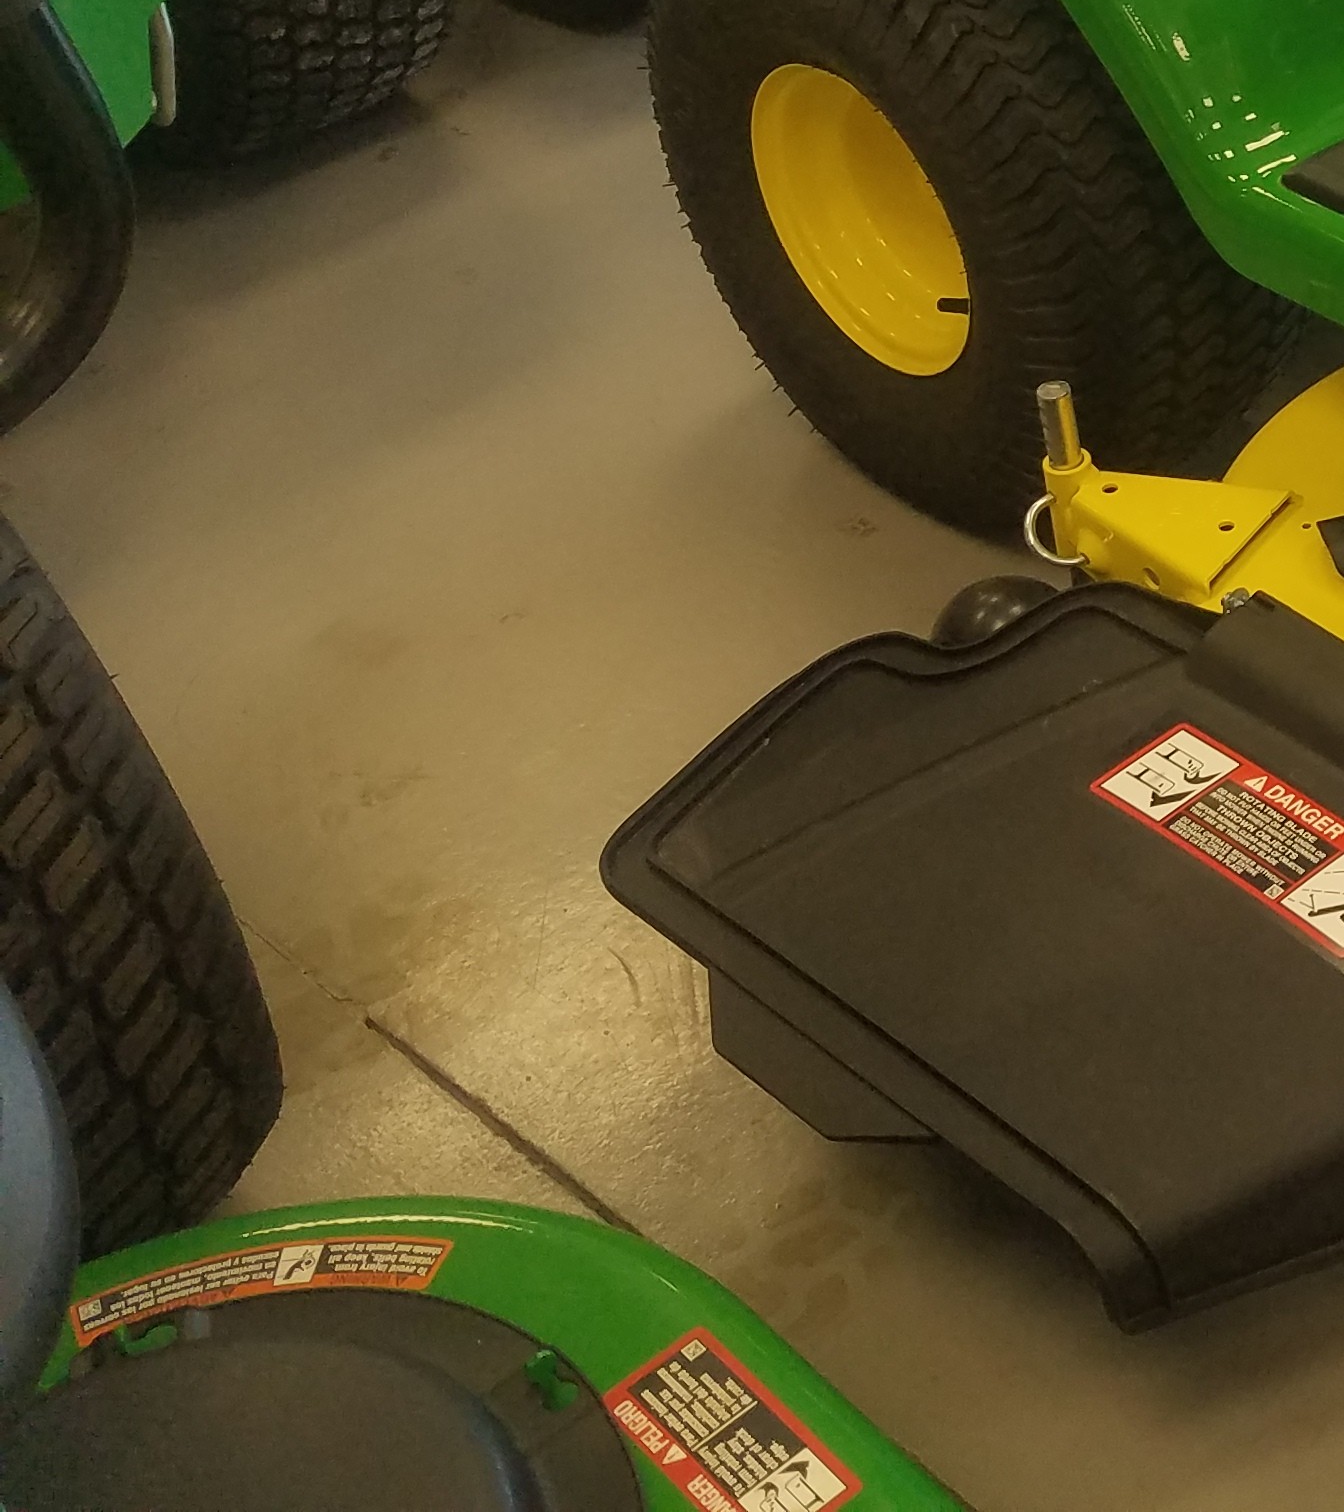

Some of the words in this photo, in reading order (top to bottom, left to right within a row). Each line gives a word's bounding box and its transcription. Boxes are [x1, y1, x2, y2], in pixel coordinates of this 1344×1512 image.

[1217, 805, 1257, 832] THROWN
[1256, 831, 1298, 859] OBJECTS
[1239, 792, 1286, 822] ROTATING
[1285, 820, 1317, 843] BLADE
[1264, 785, 1344, 840] DANGER
[613, 1399, 670, 1455] PELIGRO
